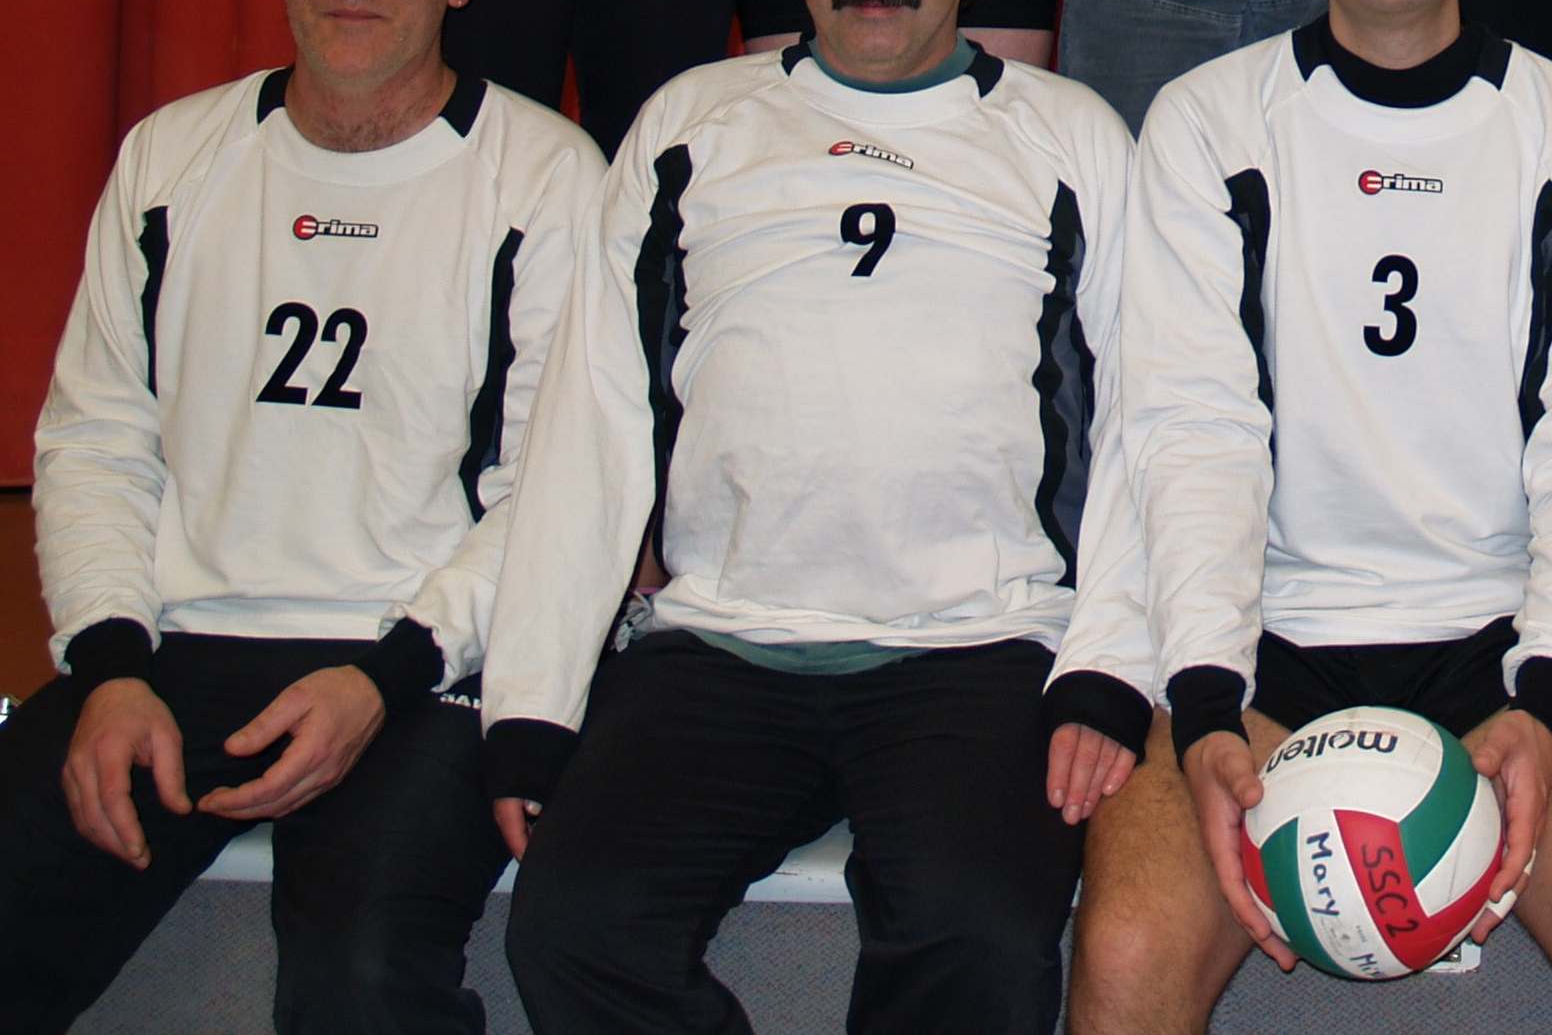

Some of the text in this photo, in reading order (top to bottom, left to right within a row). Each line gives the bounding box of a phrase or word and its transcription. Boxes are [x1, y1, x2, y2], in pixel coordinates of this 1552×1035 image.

[840, 203, 896, 277] 9
[1363, 254, 1419, 357] 3
[255, 302, 368, 410] 22
[1265, 729, 1399, 774] molten
[1306, 832, 1340, 918] Mary
